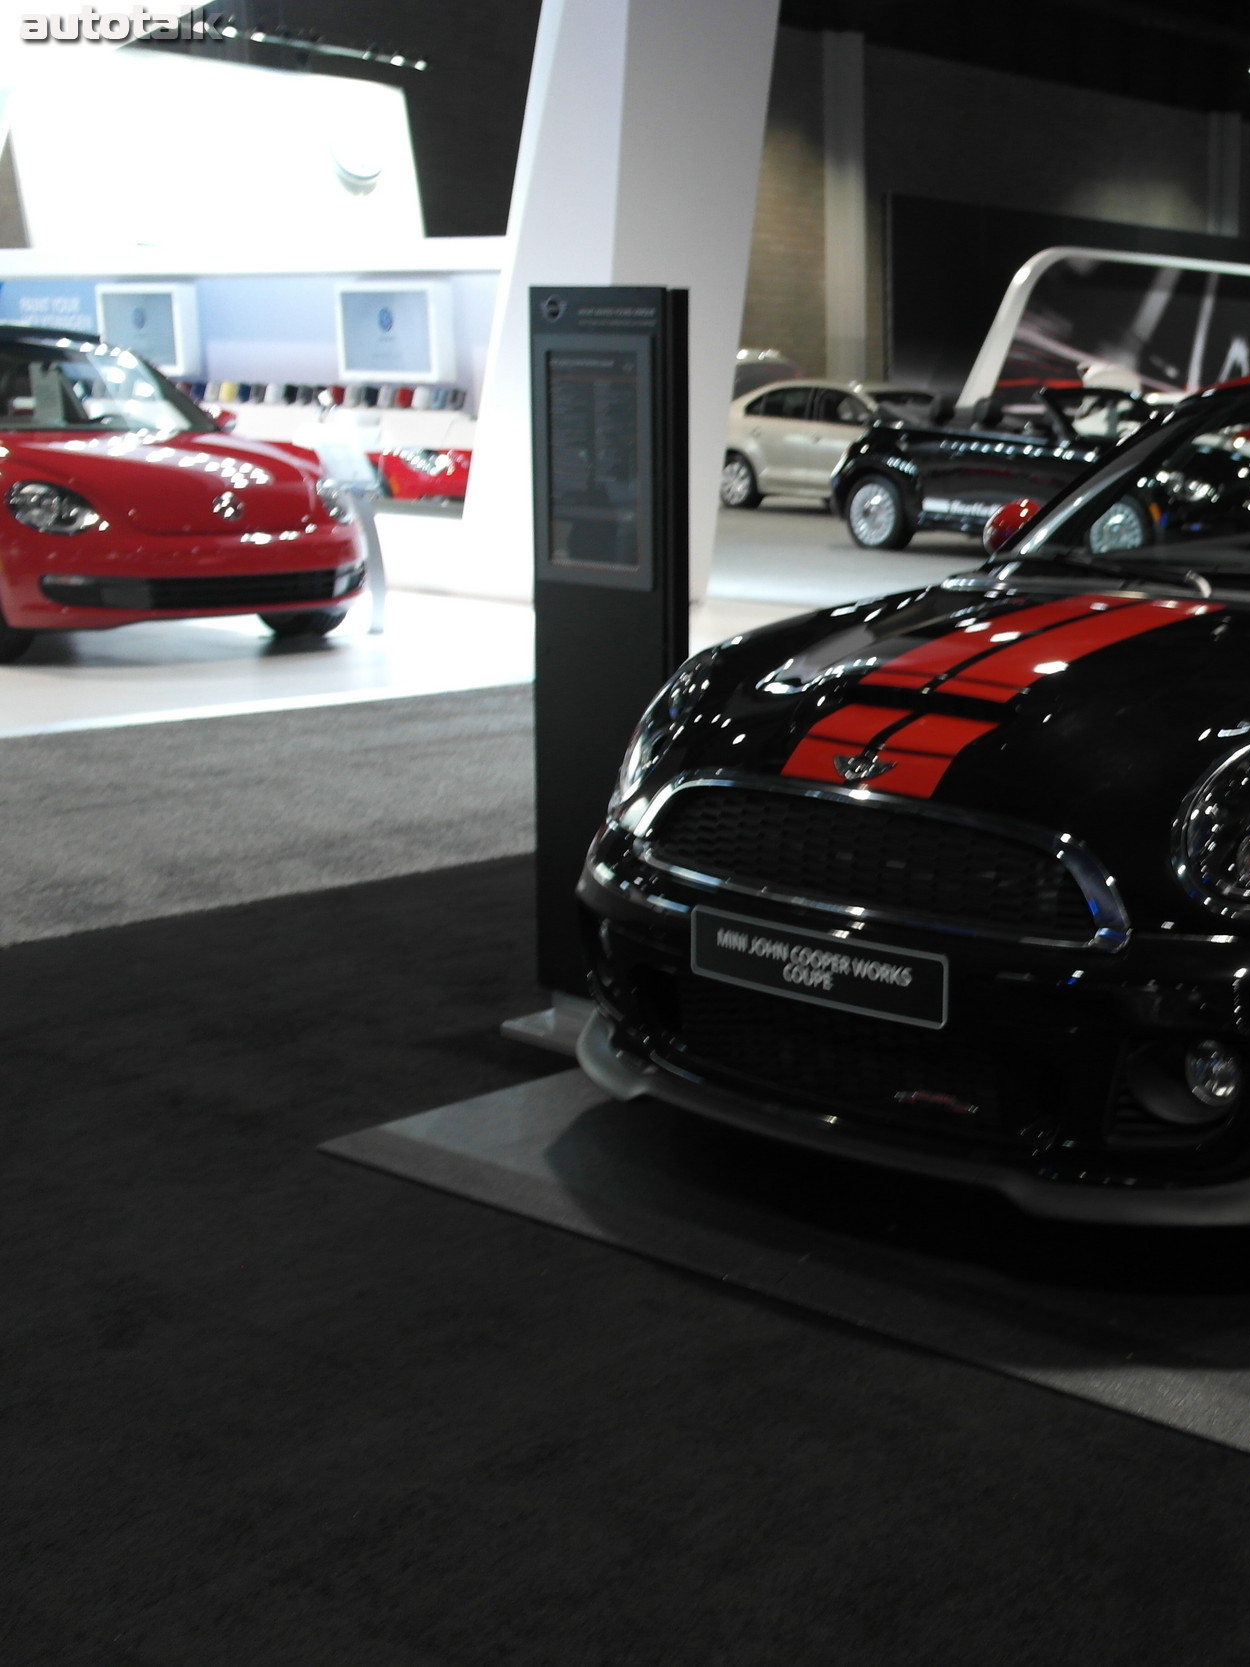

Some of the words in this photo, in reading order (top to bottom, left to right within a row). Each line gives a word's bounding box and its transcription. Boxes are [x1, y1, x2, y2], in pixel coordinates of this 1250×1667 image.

[716, 927, 748, 952] MINI
[748, 936, 789, 962] JOHN
[789, 945, 851, 976] COOPER
[852, 957, 912, 987] WORKS
